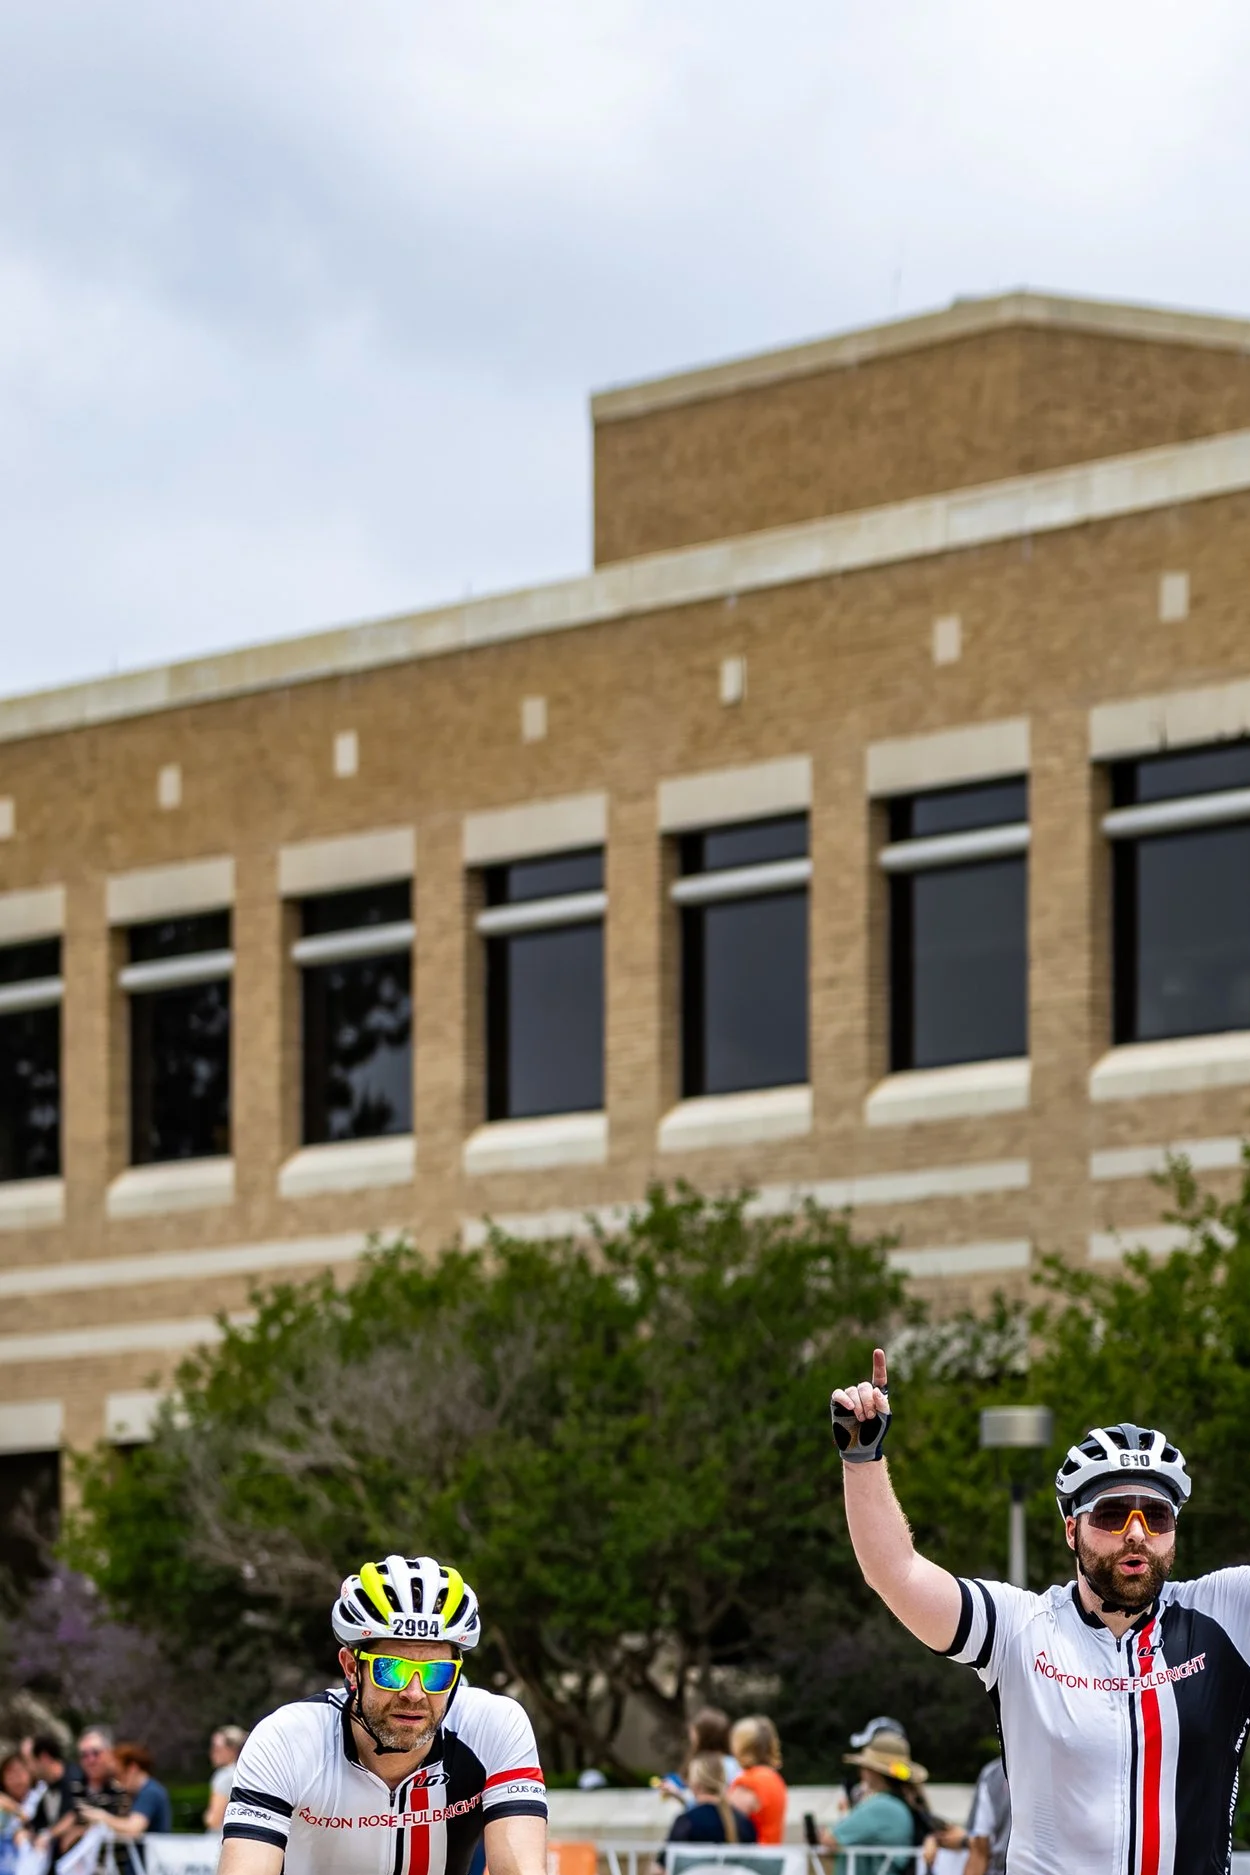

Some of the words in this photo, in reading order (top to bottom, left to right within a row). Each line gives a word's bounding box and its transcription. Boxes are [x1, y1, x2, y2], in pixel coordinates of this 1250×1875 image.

[392, 1618, 440, 1638] 2994
[1093, 1677, 1129, 1691] ROSE
[1131, 1652, 1206, 1691] FULBRIGHT
[358, 1814, 398, 1829] ROSE
[402, 1791, 482, 1827] FULBRIGHT
